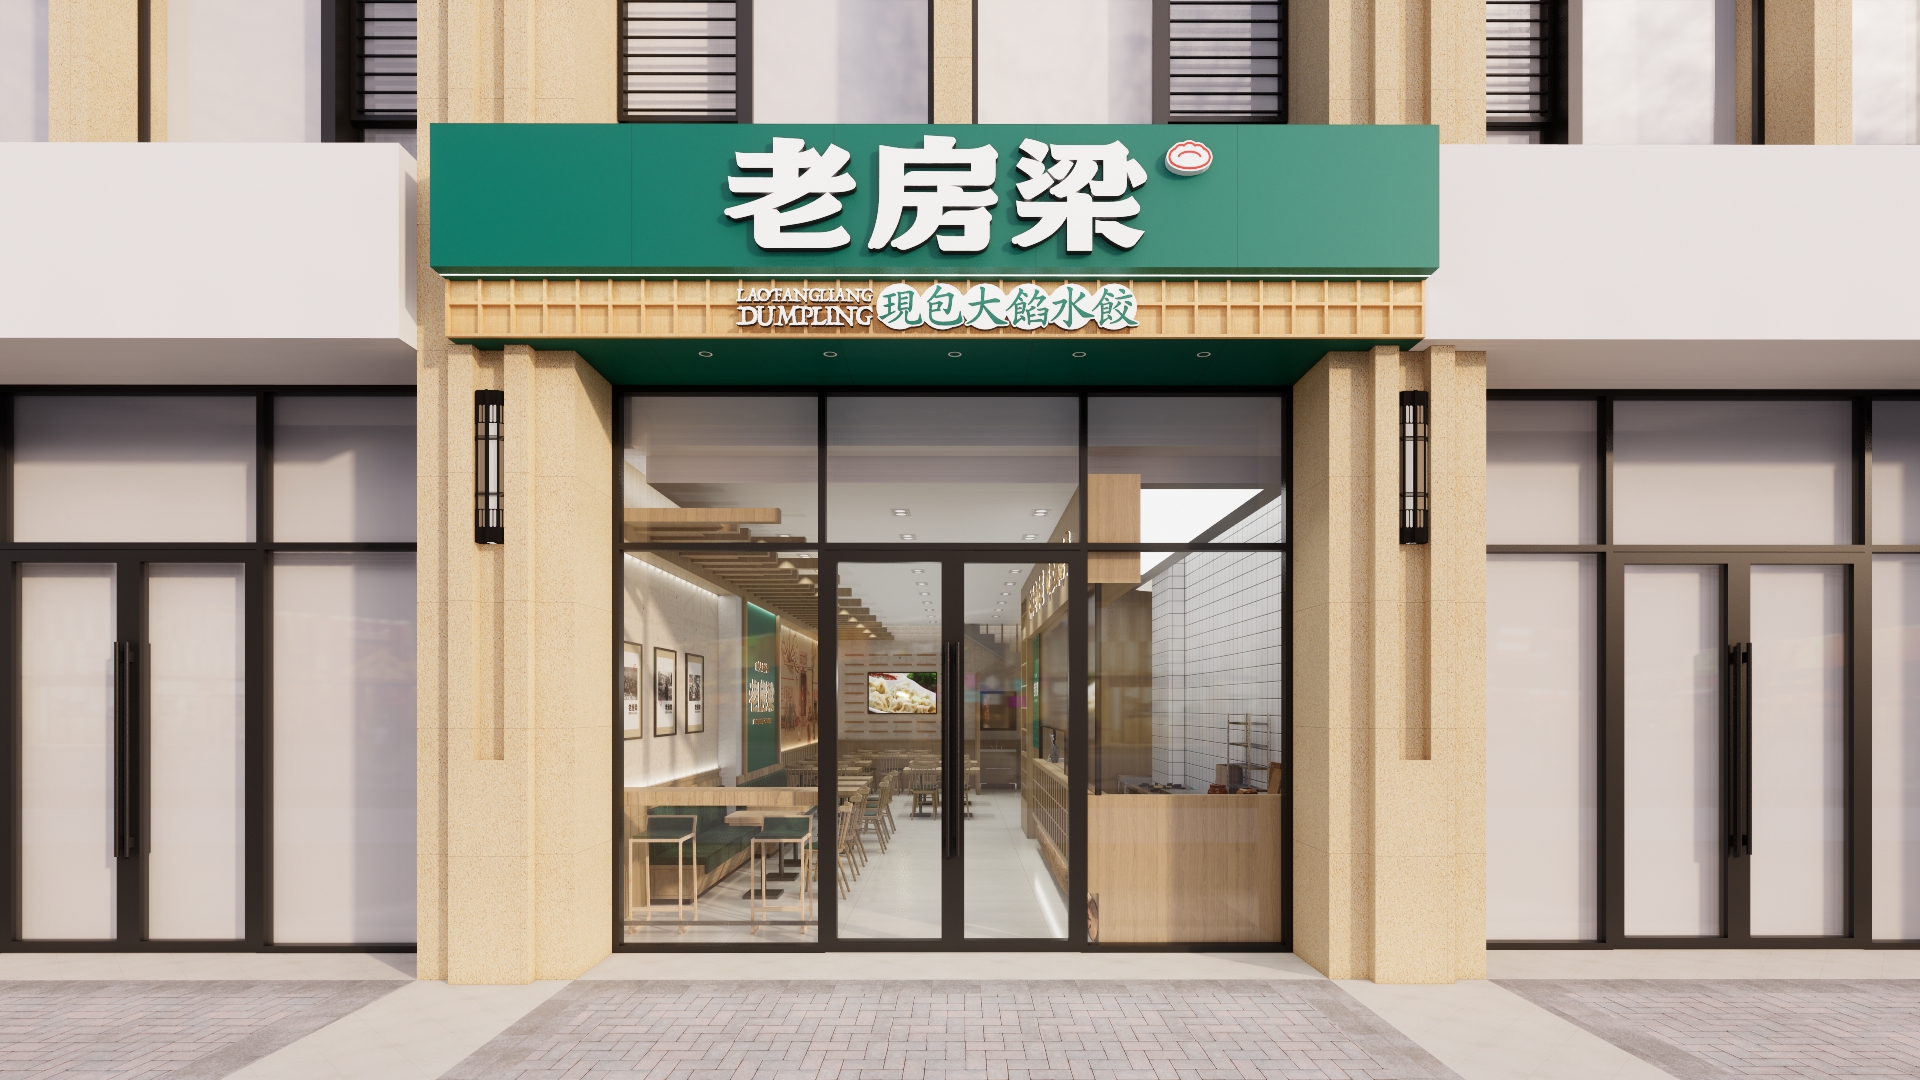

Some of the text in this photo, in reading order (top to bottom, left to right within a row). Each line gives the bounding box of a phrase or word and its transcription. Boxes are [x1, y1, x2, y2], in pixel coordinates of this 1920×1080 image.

[724, 135, 1147, 253] 老房梁
[736, 288, 873, 303] LAOFANGLIANG
[878, 285, 1138, 328] 現包大餡水餃
[736, 305, 873, 327] DUMPLING
